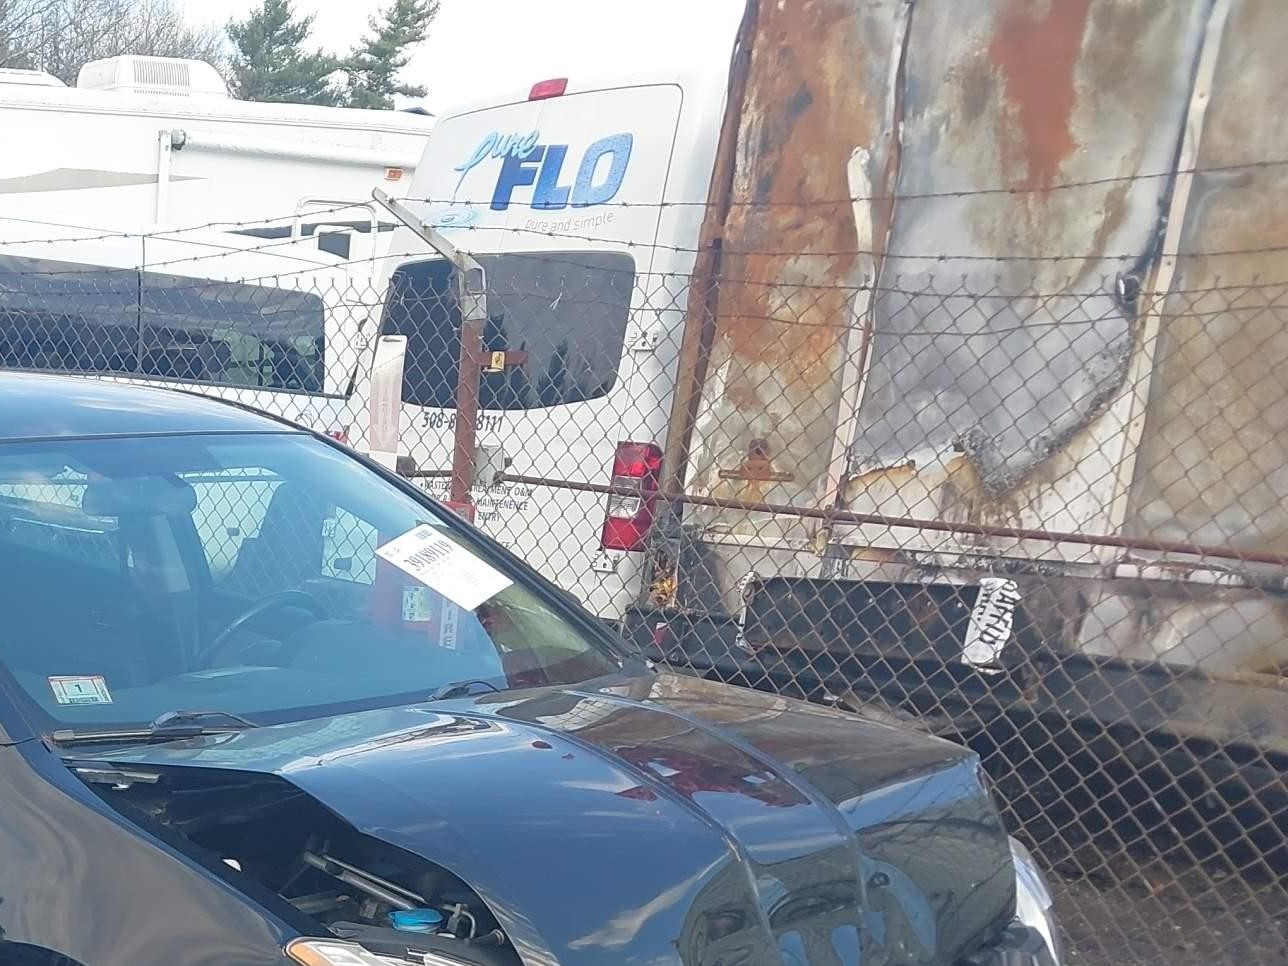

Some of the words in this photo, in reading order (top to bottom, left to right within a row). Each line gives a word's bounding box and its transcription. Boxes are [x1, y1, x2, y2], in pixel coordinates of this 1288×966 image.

[489, 132, 634, 211] FLO
[525, 218, 549, 232] pure
[551, 218, 570, 232] and
[573, 210, 615, 231] simple
[403, 539, 454, 572] 39189119
